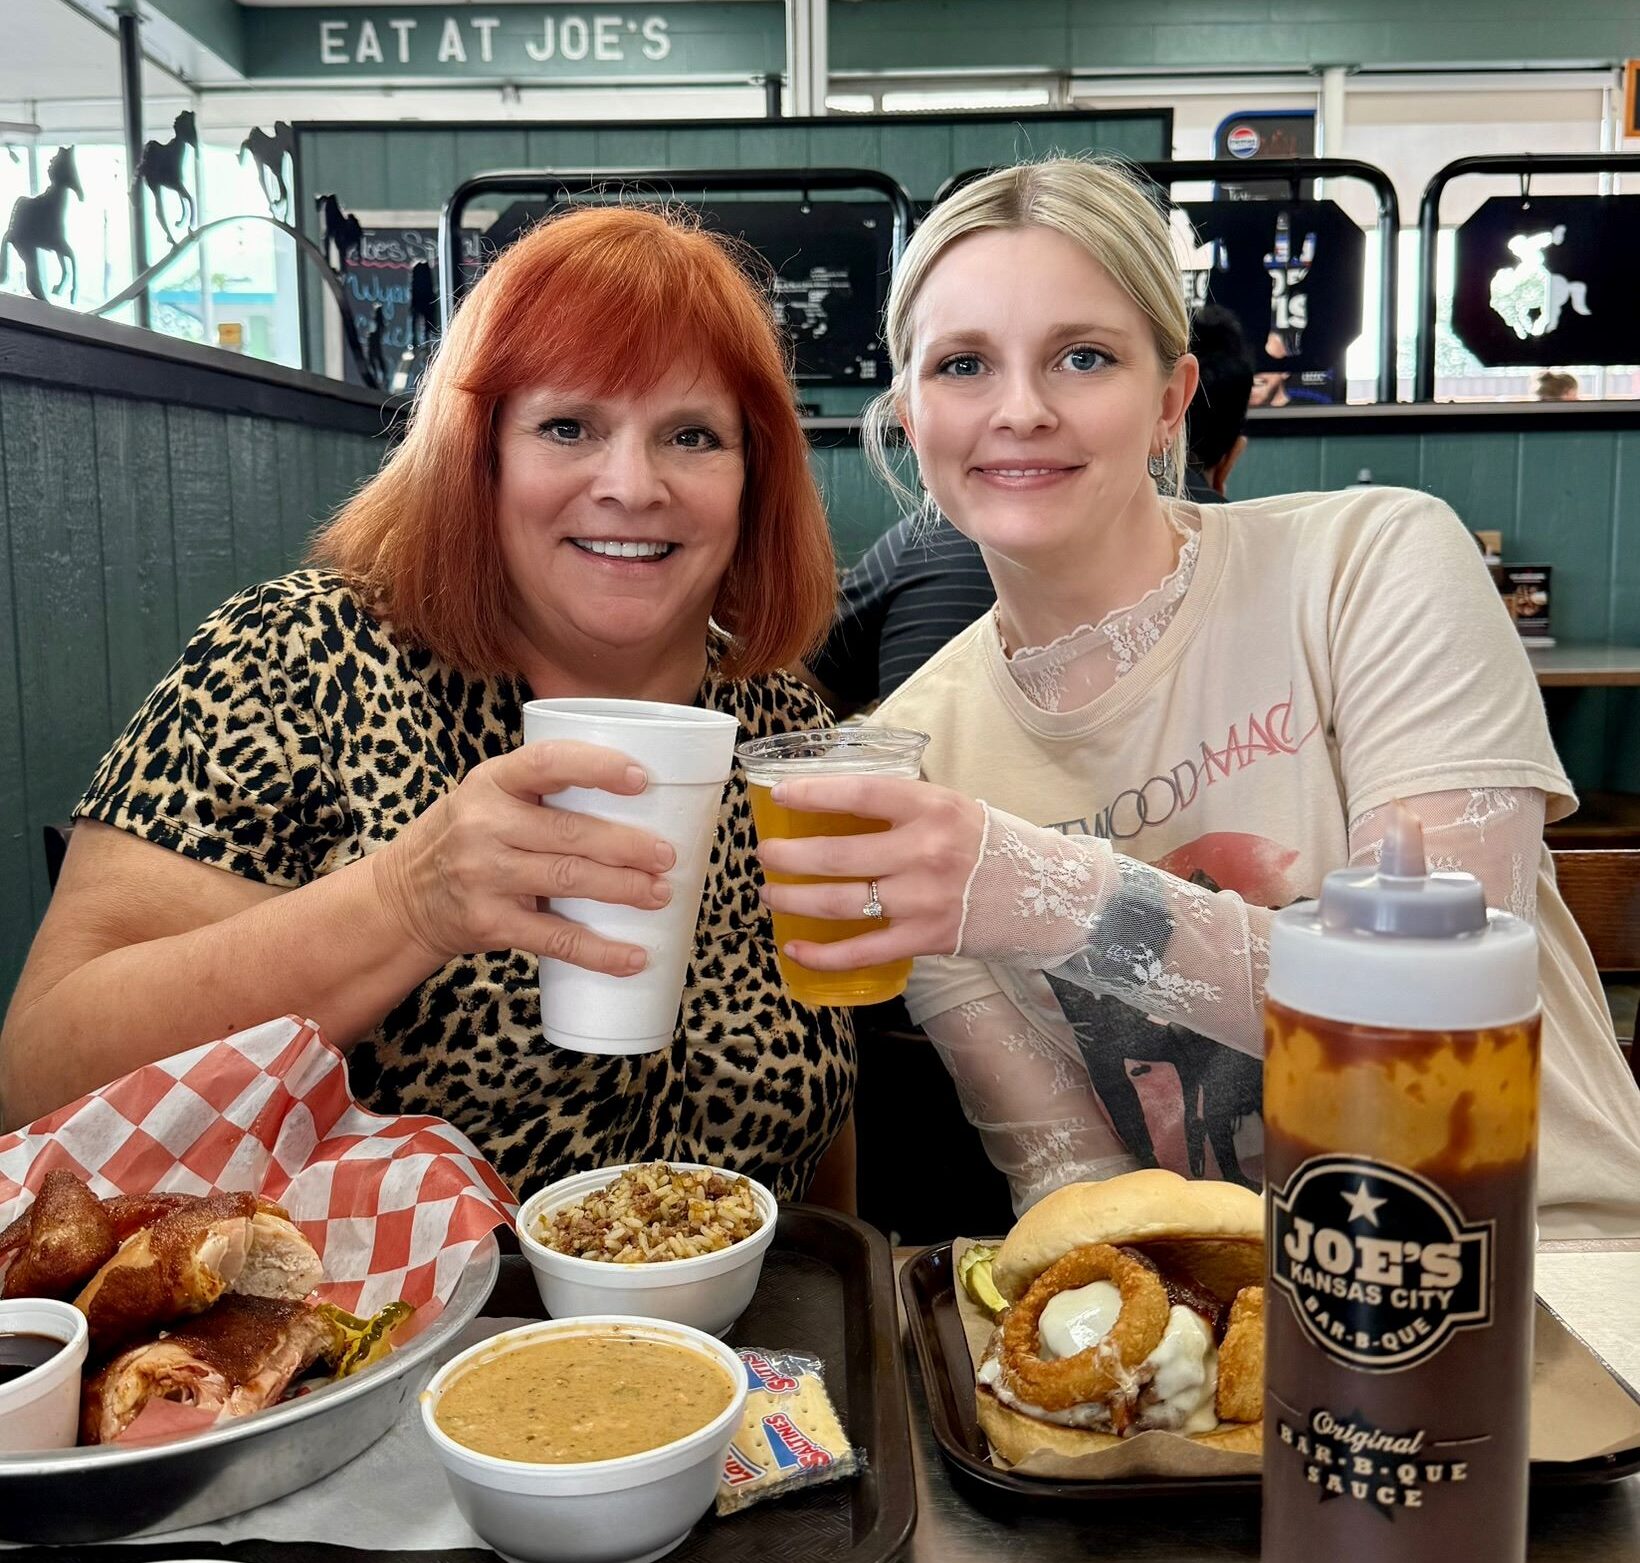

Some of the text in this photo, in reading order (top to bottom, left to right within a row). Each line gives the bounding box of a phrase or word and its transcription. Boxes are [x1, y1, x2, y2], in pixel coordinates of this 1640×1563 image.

[319, 15, 673, 65] EAT AT JOE'S
[1041, 682, 1319, 840] TWOOD MAC
[1283, 1216, 1463, 1288] JOE'S
[1290, 1261, 1454, 1310] KANSAS CITY
[1304, 1295, 1432, 1351] BAR-B-QUE
[765, 1413, 831, 1467] SALTINES
[1312, 1410, 1426, 1455] Original
[724, 1454, 755, 1485] Lan
[1307, 1465, 1423, 1508] SAUCE
